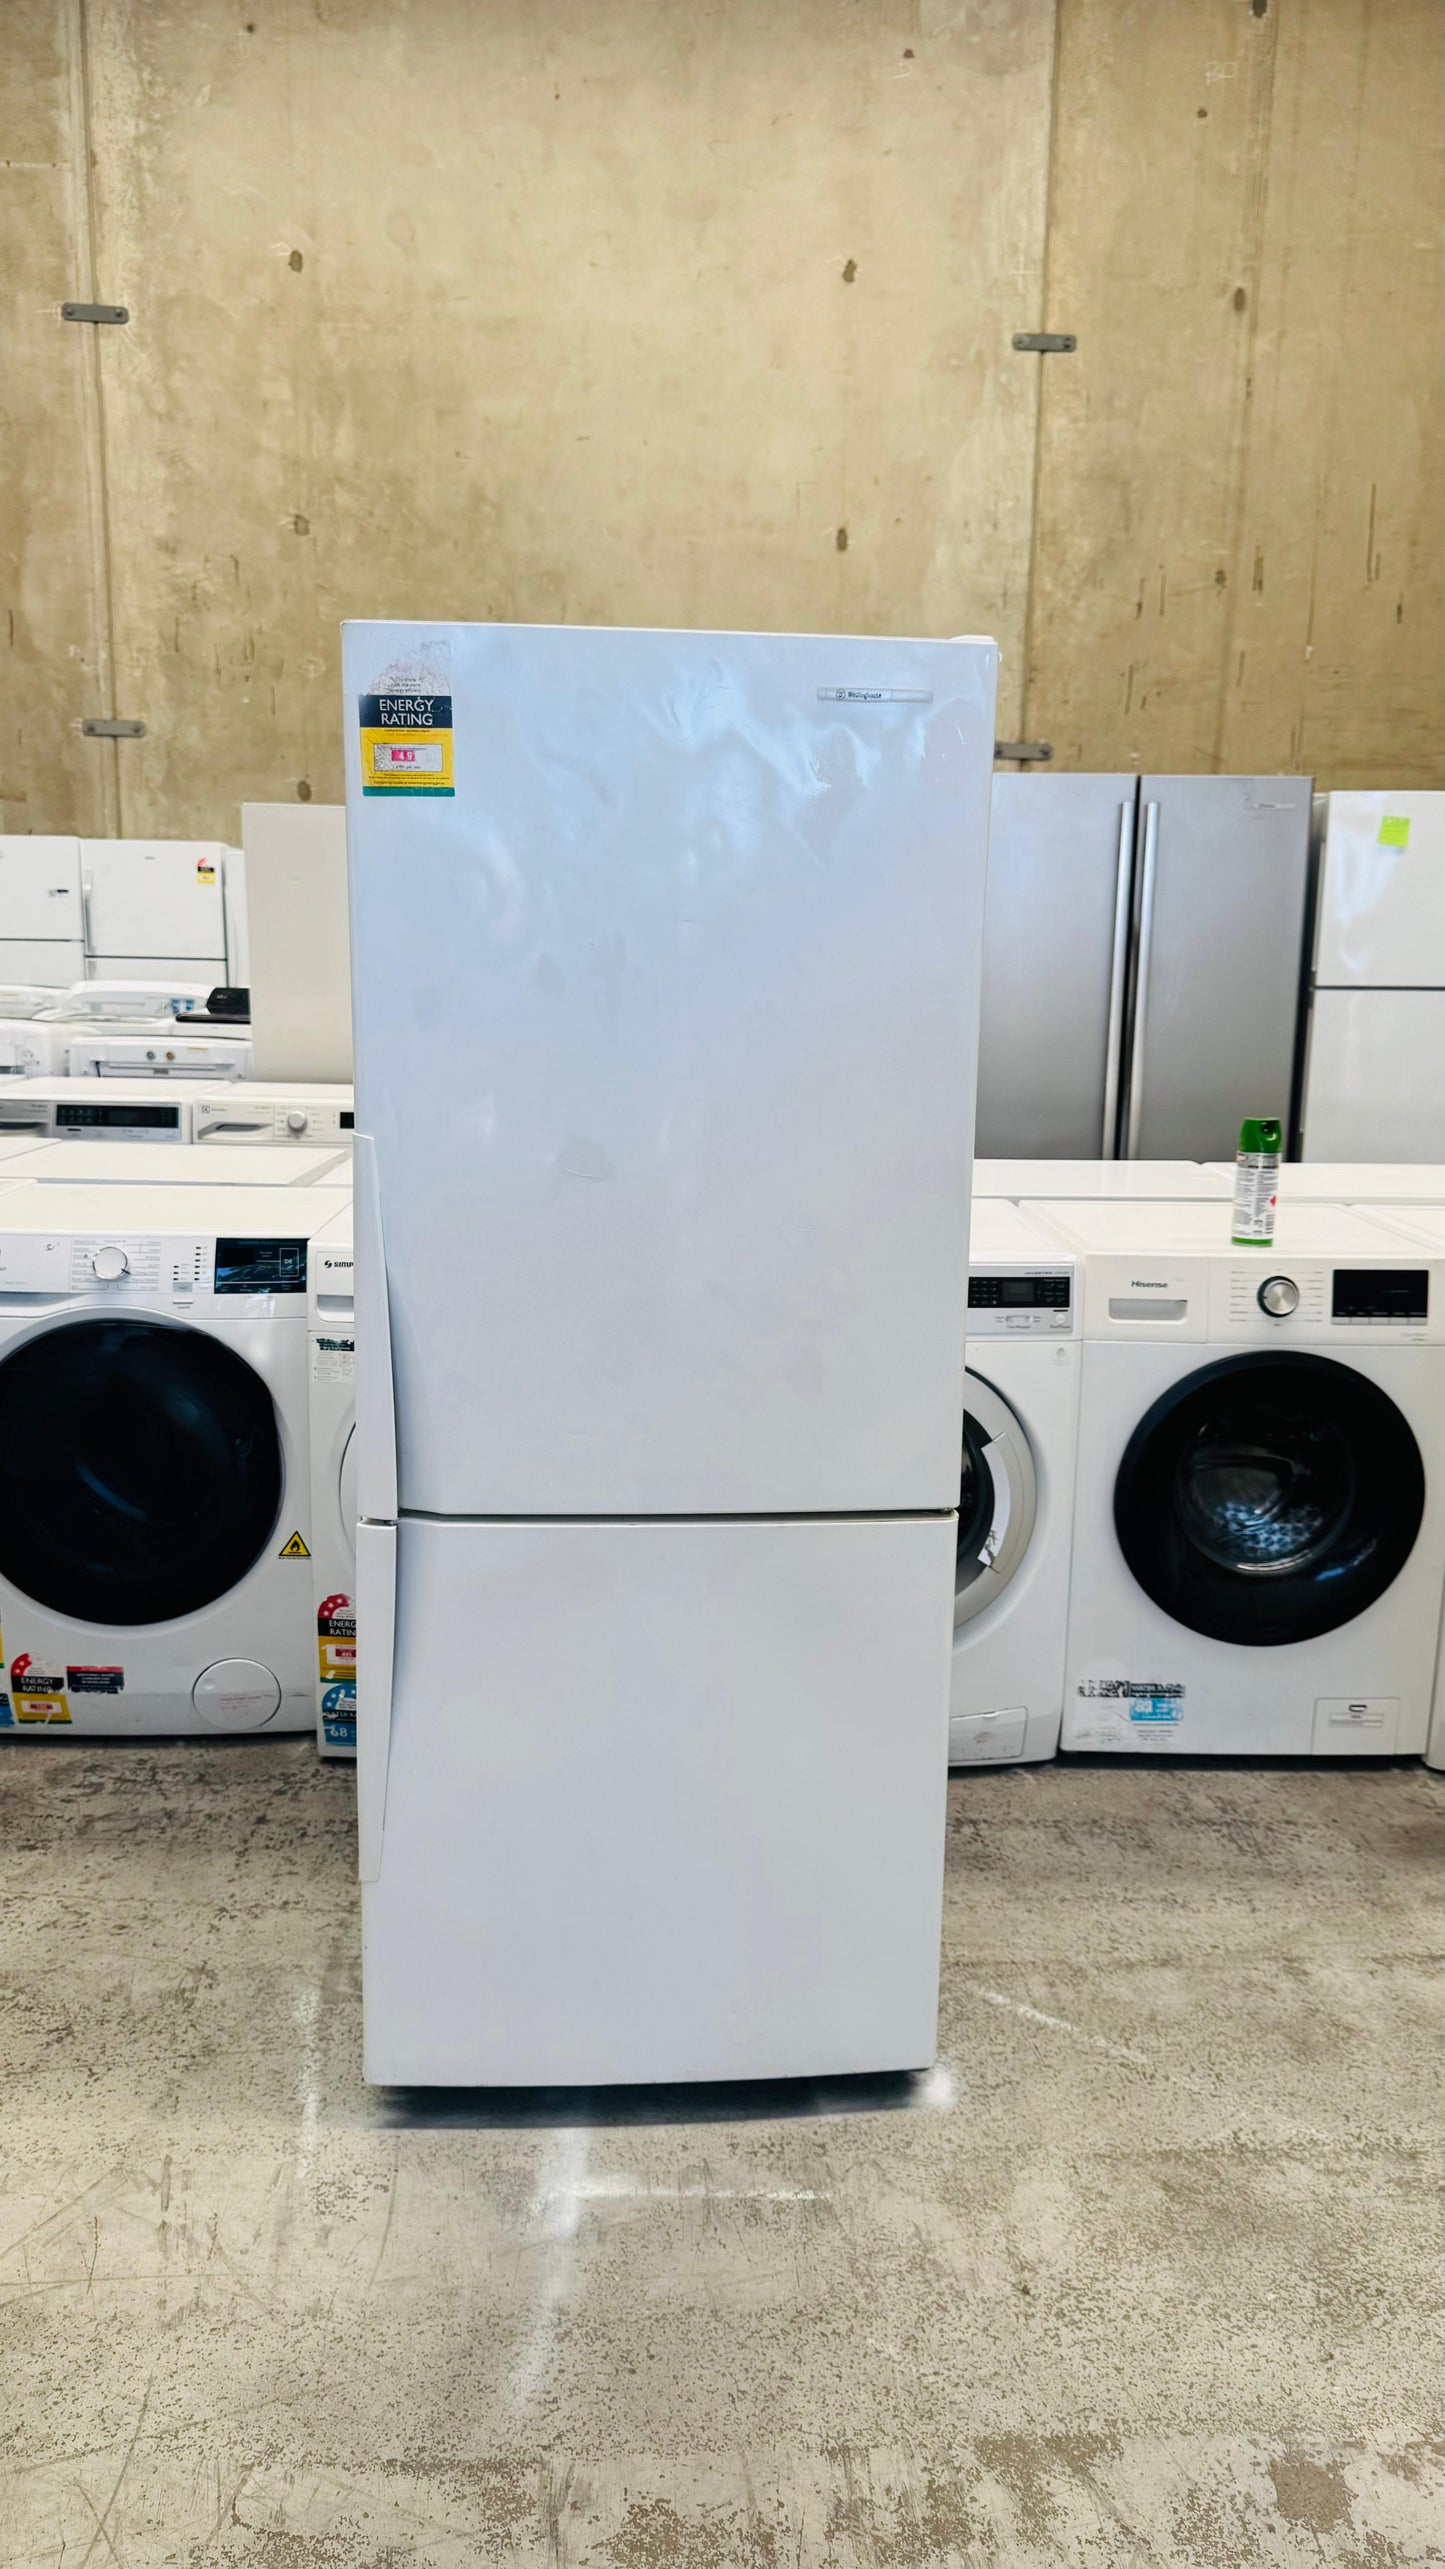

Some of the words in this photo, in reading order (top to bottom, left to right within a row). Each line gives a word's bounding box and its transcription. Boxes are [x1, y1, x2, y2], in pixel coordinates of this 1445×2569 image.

[379, 699, 434, 712] ENERGY
[381, 713, 433, 726] RATING
[1131, 1280, 1168, 1288] Hisense
[20, 1677, 54, 1685] ENERGY
